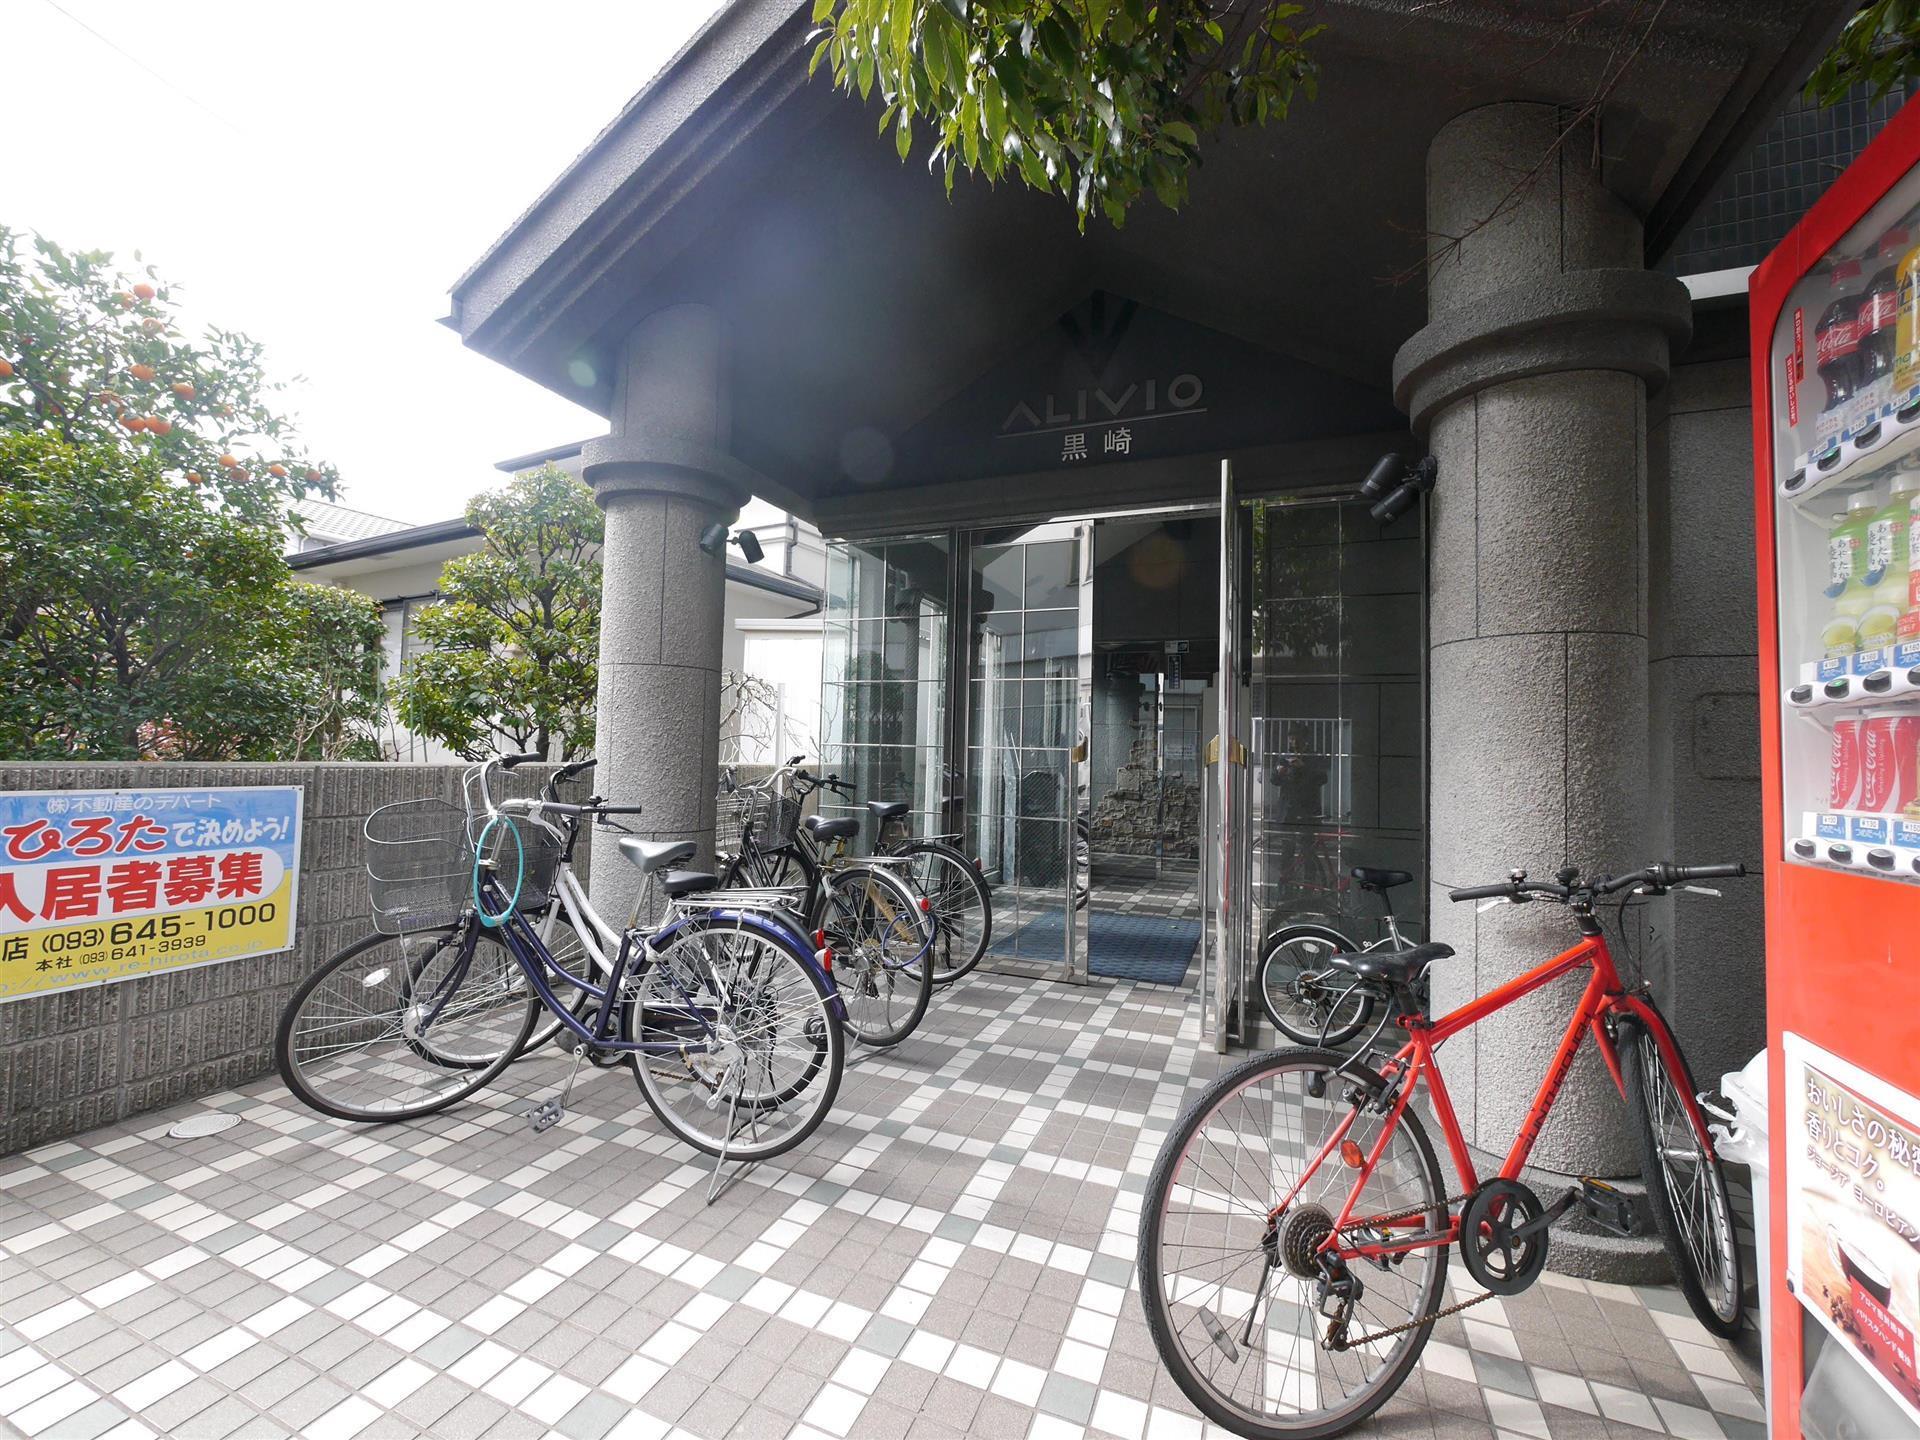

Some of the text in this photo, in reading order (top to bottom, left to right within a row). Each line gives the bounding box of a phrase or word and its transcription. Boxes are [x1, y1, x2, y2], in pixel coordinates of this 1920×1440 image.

[1002, 373, 1204, 430] ALIVIO
[1061, 427, 1133, 462] 黒崎
[35, 956, 73, 972] 本社
